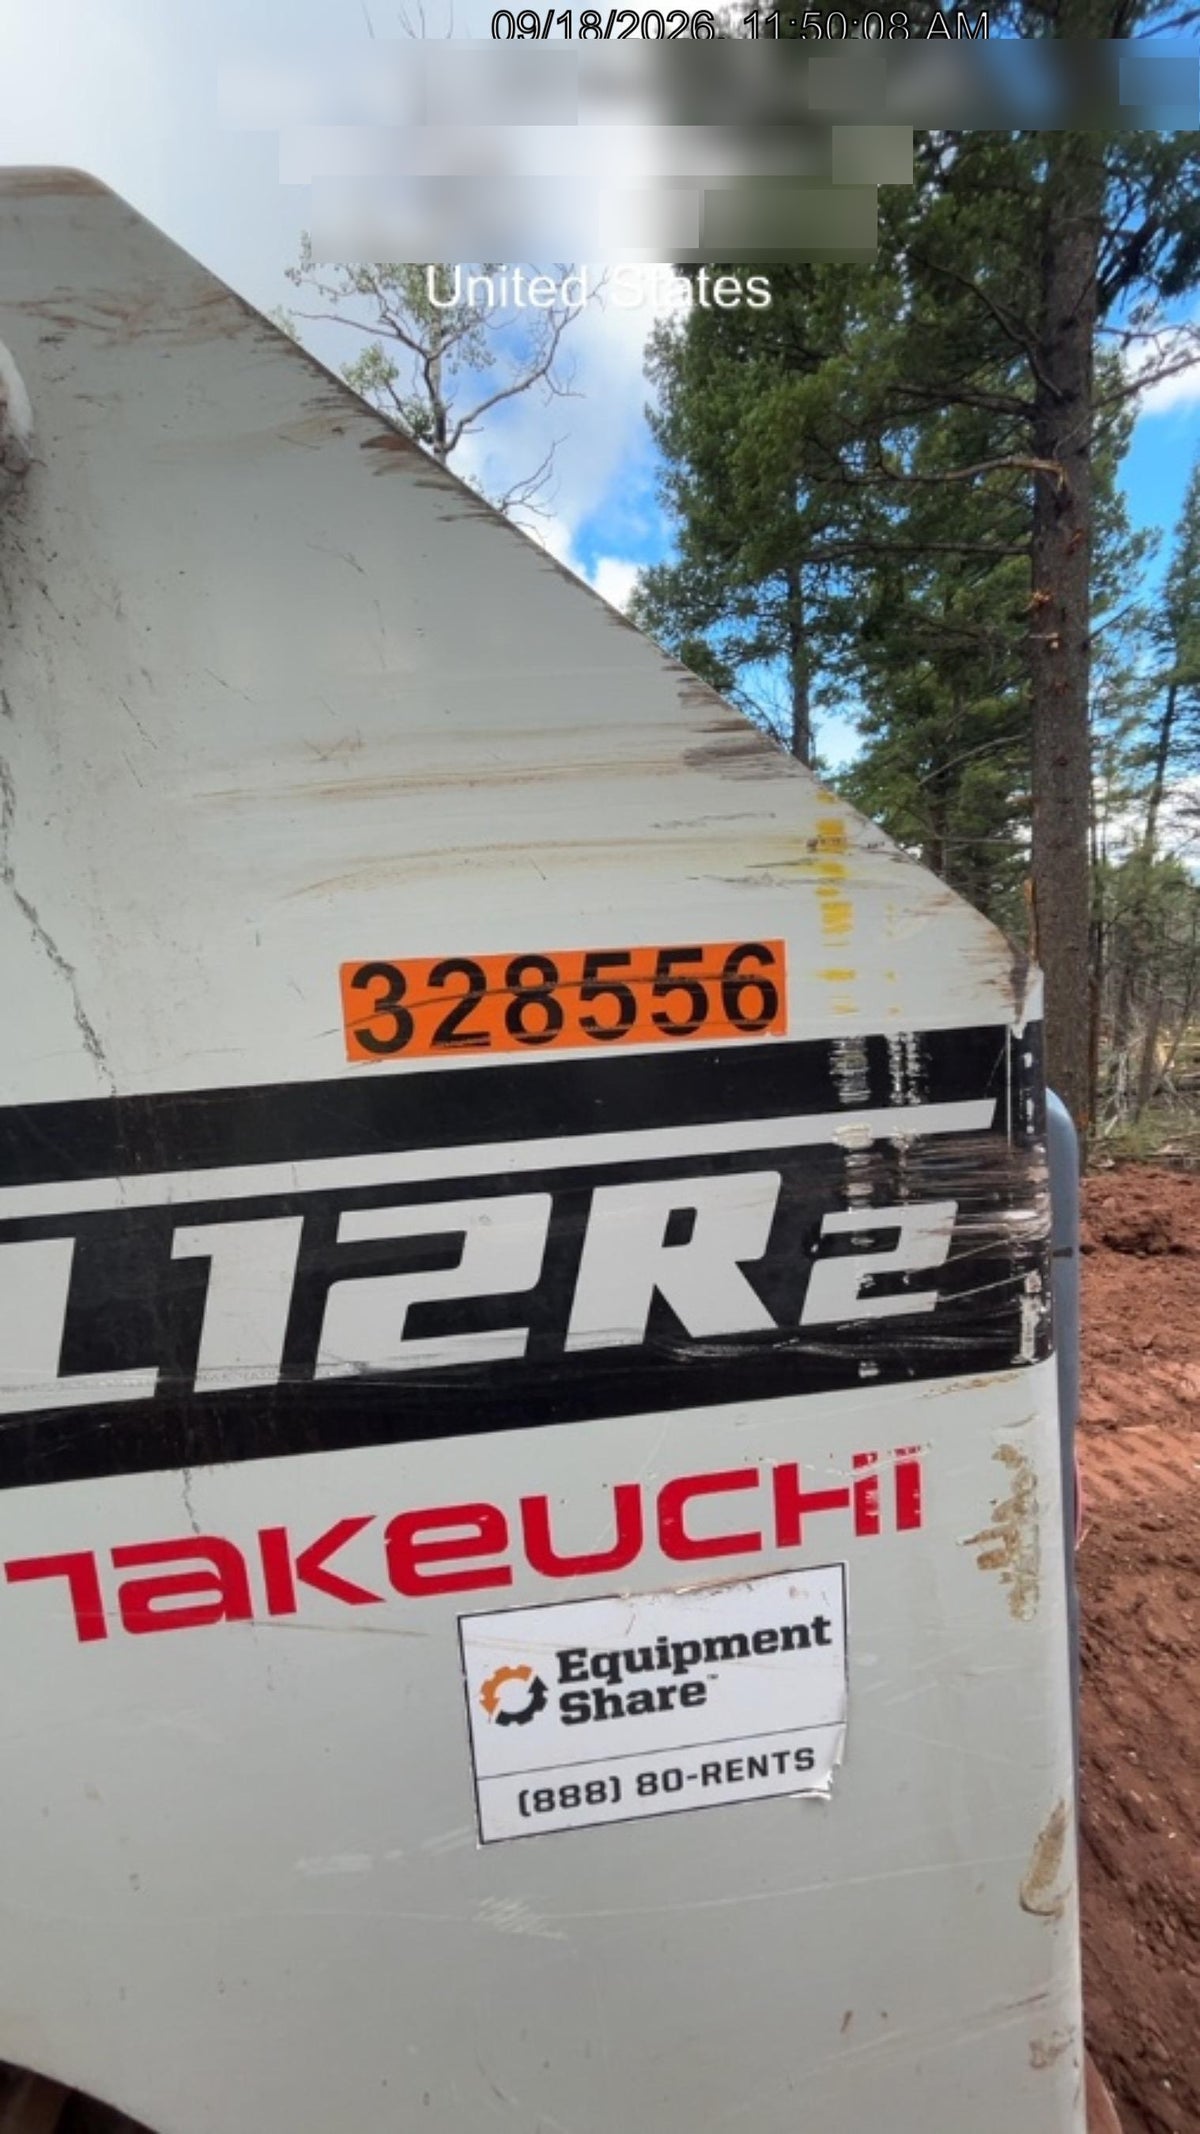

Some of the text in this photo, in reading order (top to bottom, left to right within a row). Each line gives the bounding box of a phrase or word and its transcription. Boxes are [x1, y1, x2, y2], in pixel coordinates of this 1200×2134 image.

[350, 943, 780, 1054] 328556
[556, 1614, 833, 1686] Equipment
[517, 1747, 815, 1817] (888) 80-RENTS
